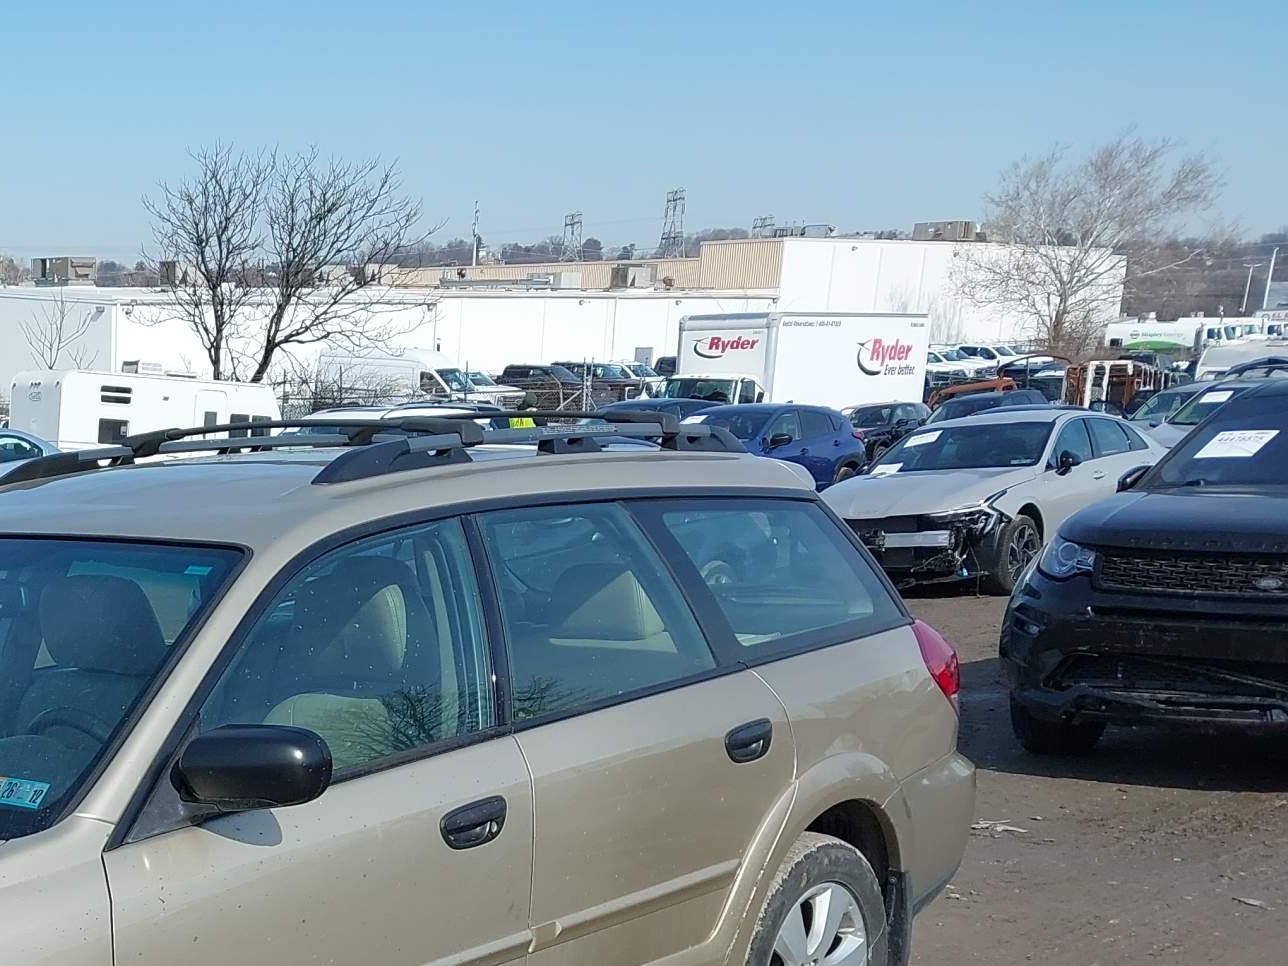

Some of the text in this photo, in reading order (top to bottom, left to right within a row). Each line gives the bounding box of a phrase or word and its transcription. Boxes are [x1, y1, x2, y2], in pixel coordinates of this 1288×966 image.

[708, 336, 759, 353] Ryder
[870, 338, 913, 367] Ryder
[884, 364, 897, 375] Ever
[1, 782, 44, 804] 26 12
